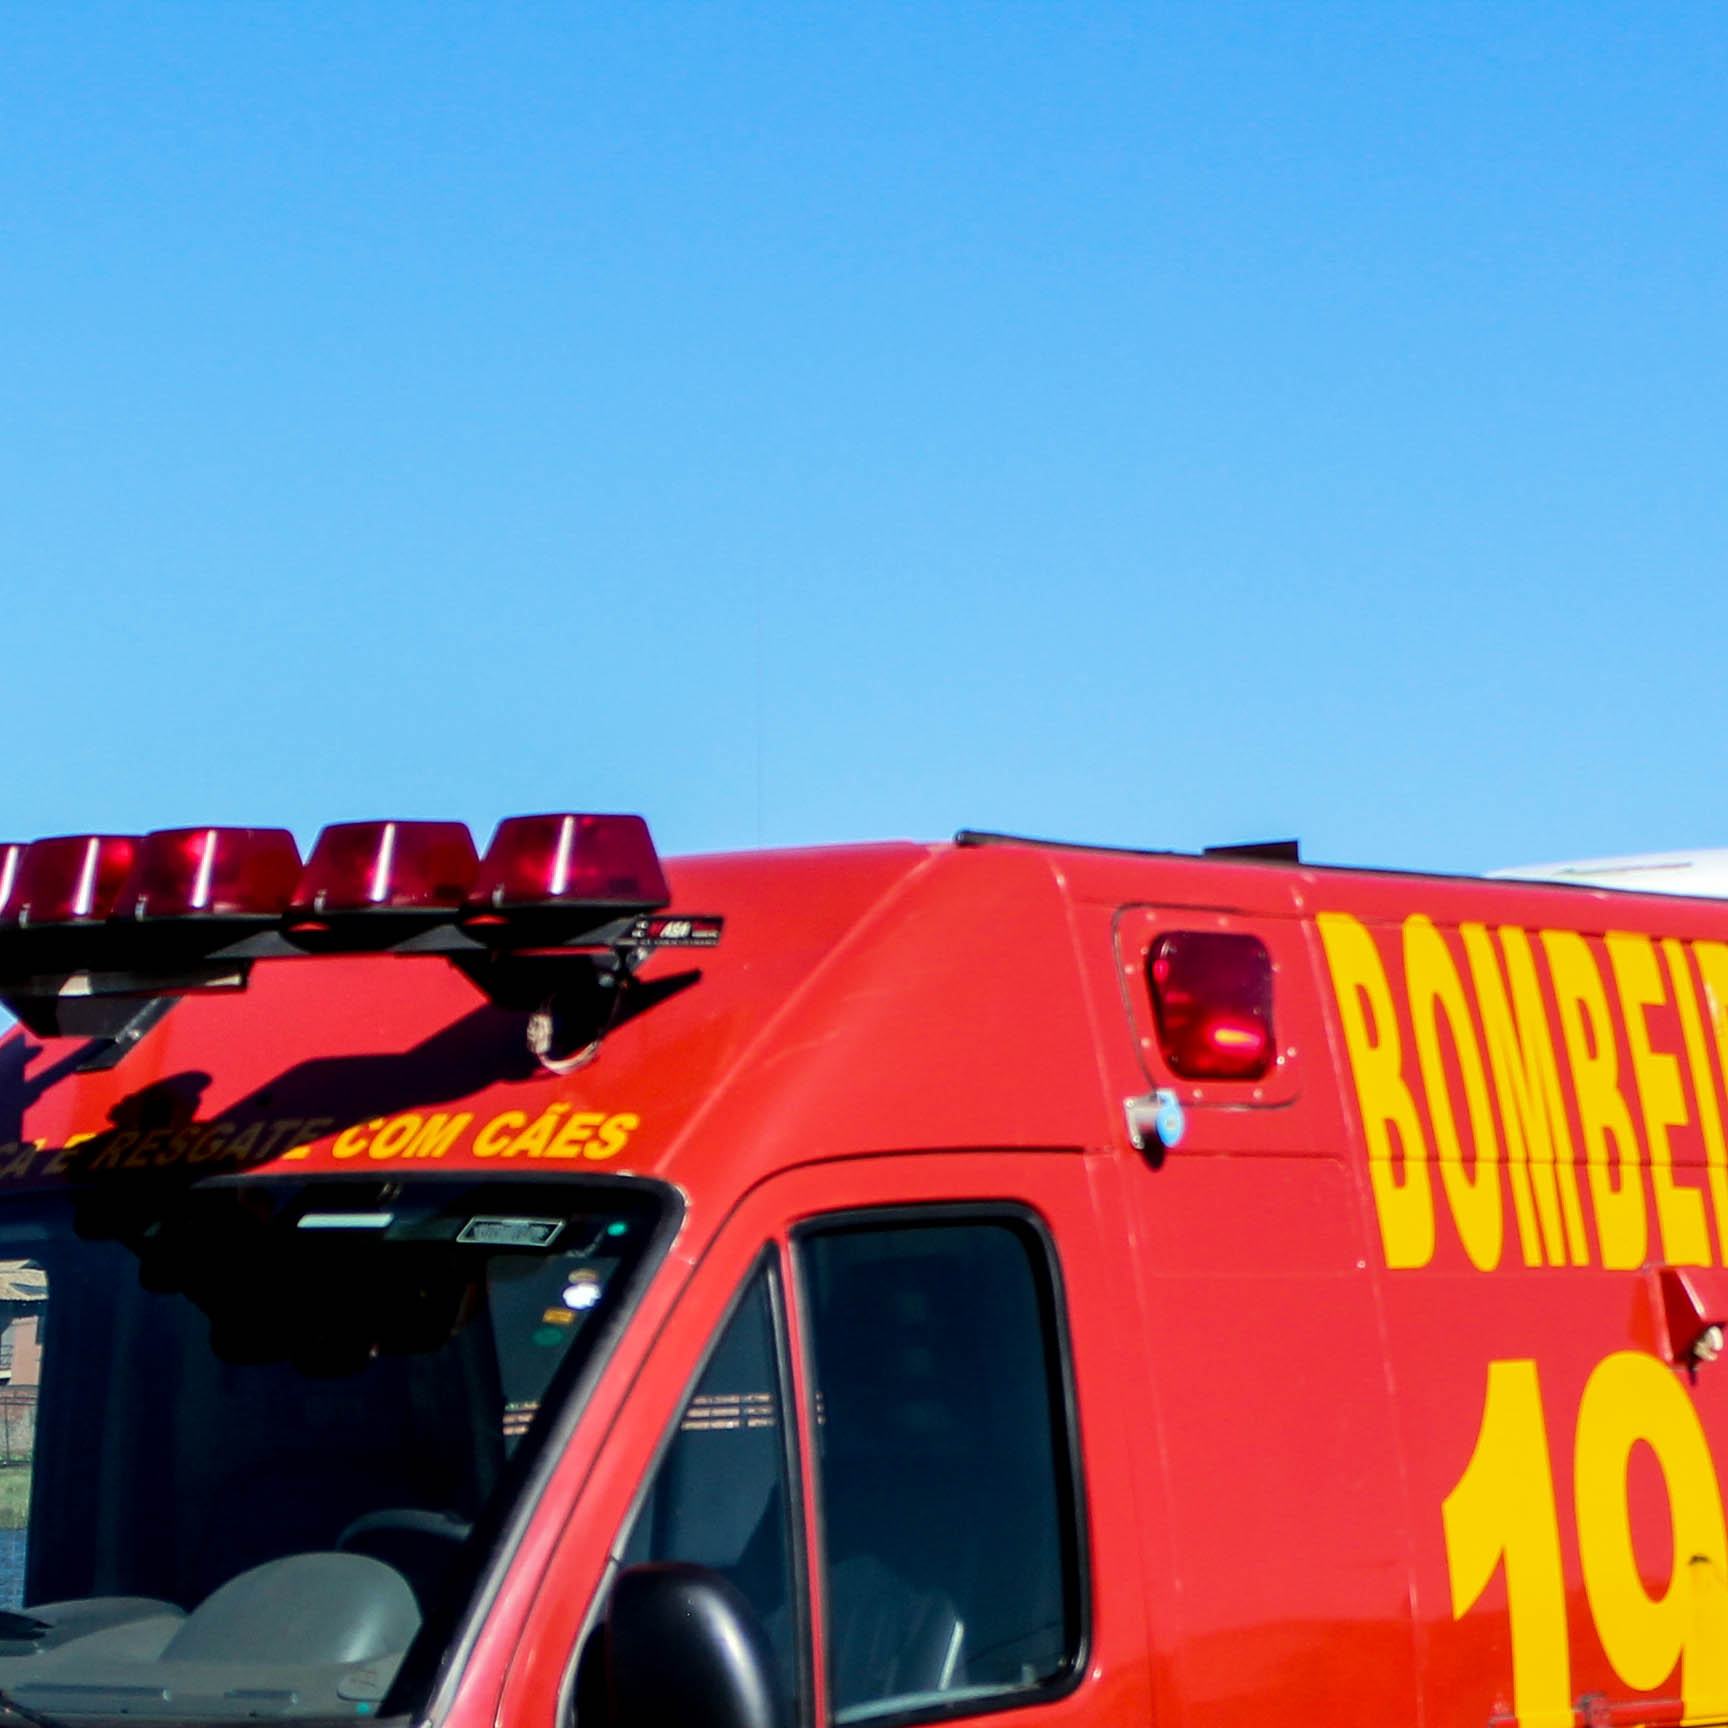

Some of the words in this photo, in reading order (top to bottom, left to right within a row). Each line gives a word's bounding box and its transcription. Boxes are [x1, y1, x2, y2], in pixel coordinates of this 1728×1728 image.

[40, 1131, 97, 1175] E
[88, 1117, 334, 1171] RESGATE
[331, 1113, 472, 1159] COM
[473, 1102, 639, 1160] CÃES
